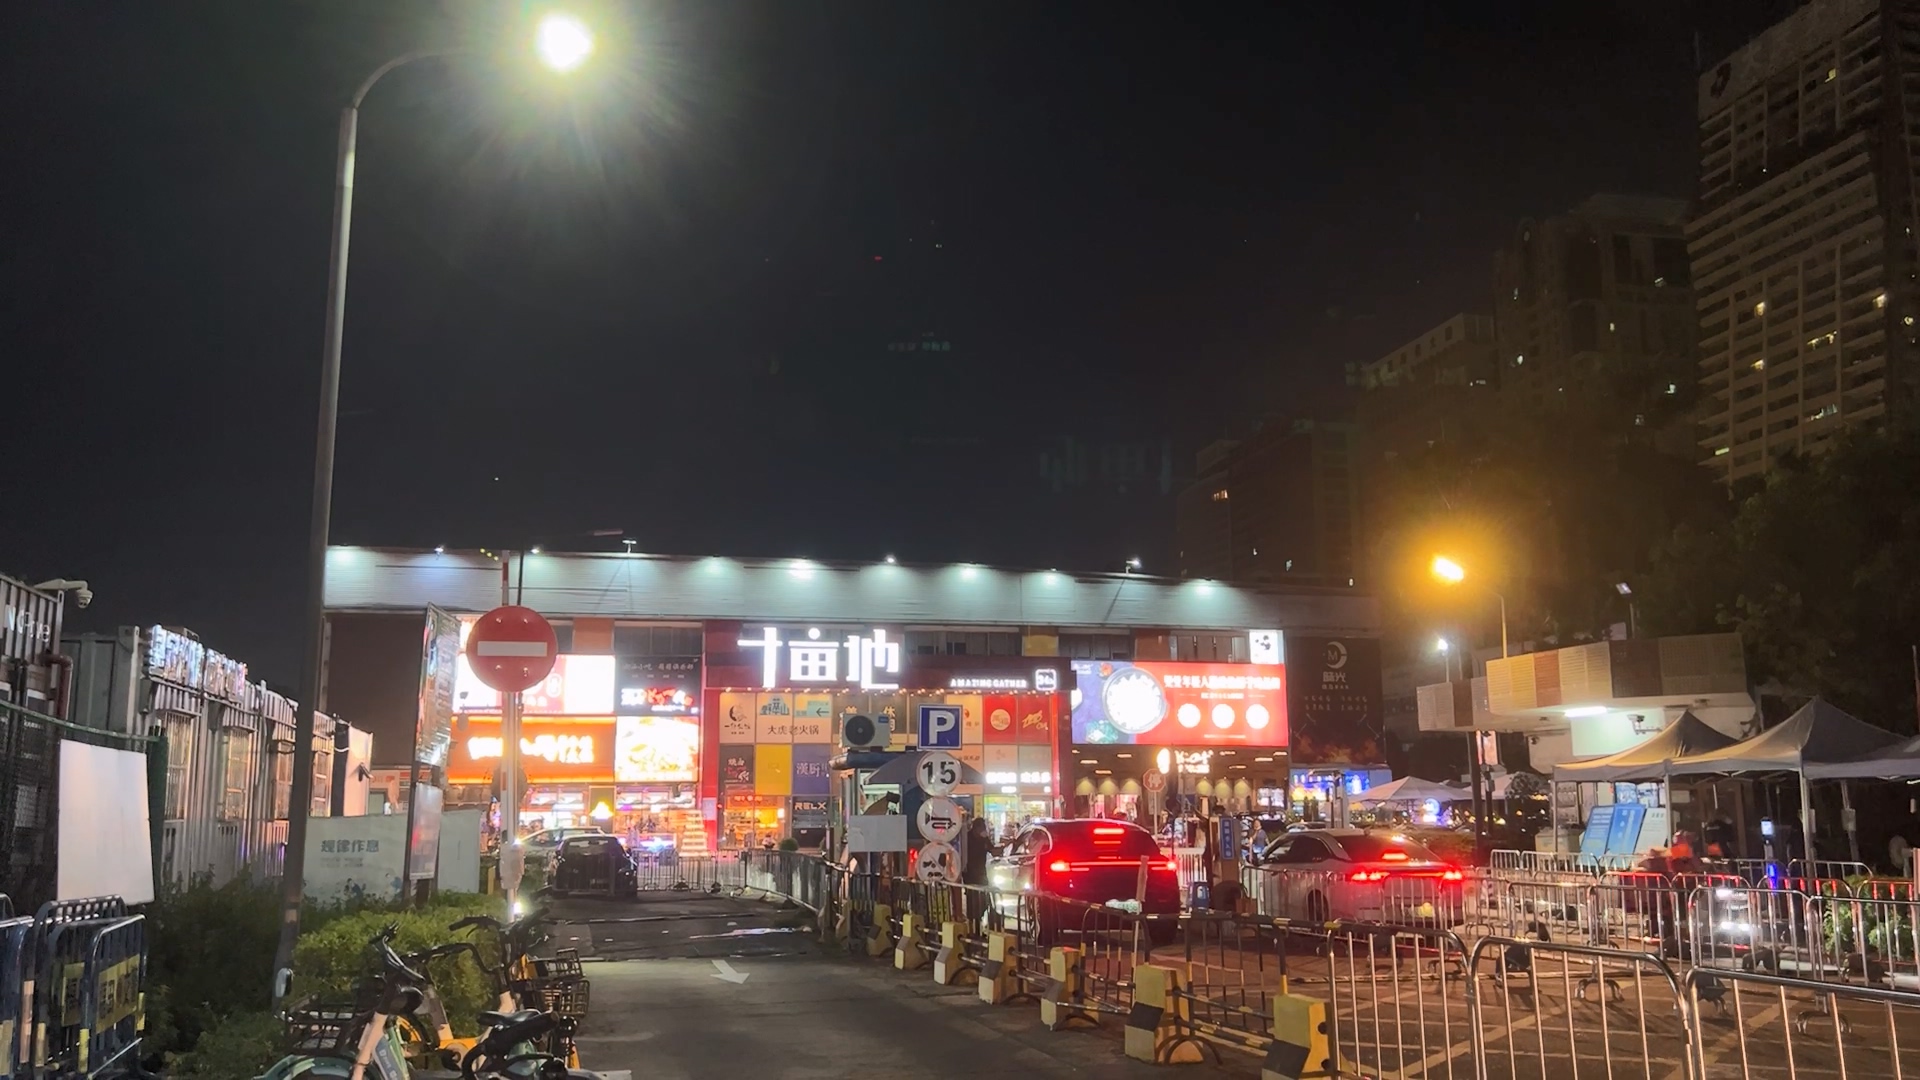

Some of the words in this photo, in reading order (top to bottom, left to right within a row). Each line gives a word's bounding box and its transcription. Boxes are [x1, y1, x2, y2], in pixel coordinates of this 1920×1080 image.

[737, 627, 899, 689] 十亩地
[950, 679, 992, 688] AMAZING
[993, 679, 1027, 689] GATHER
[768, 724, 819, 736] 大虎老火锅
[929, 710, 956, 745] P
[922, 761, 956, 785] 15
[795, 802, 827, 810] RELX
[321, 839, 379, 853] 规律作息
